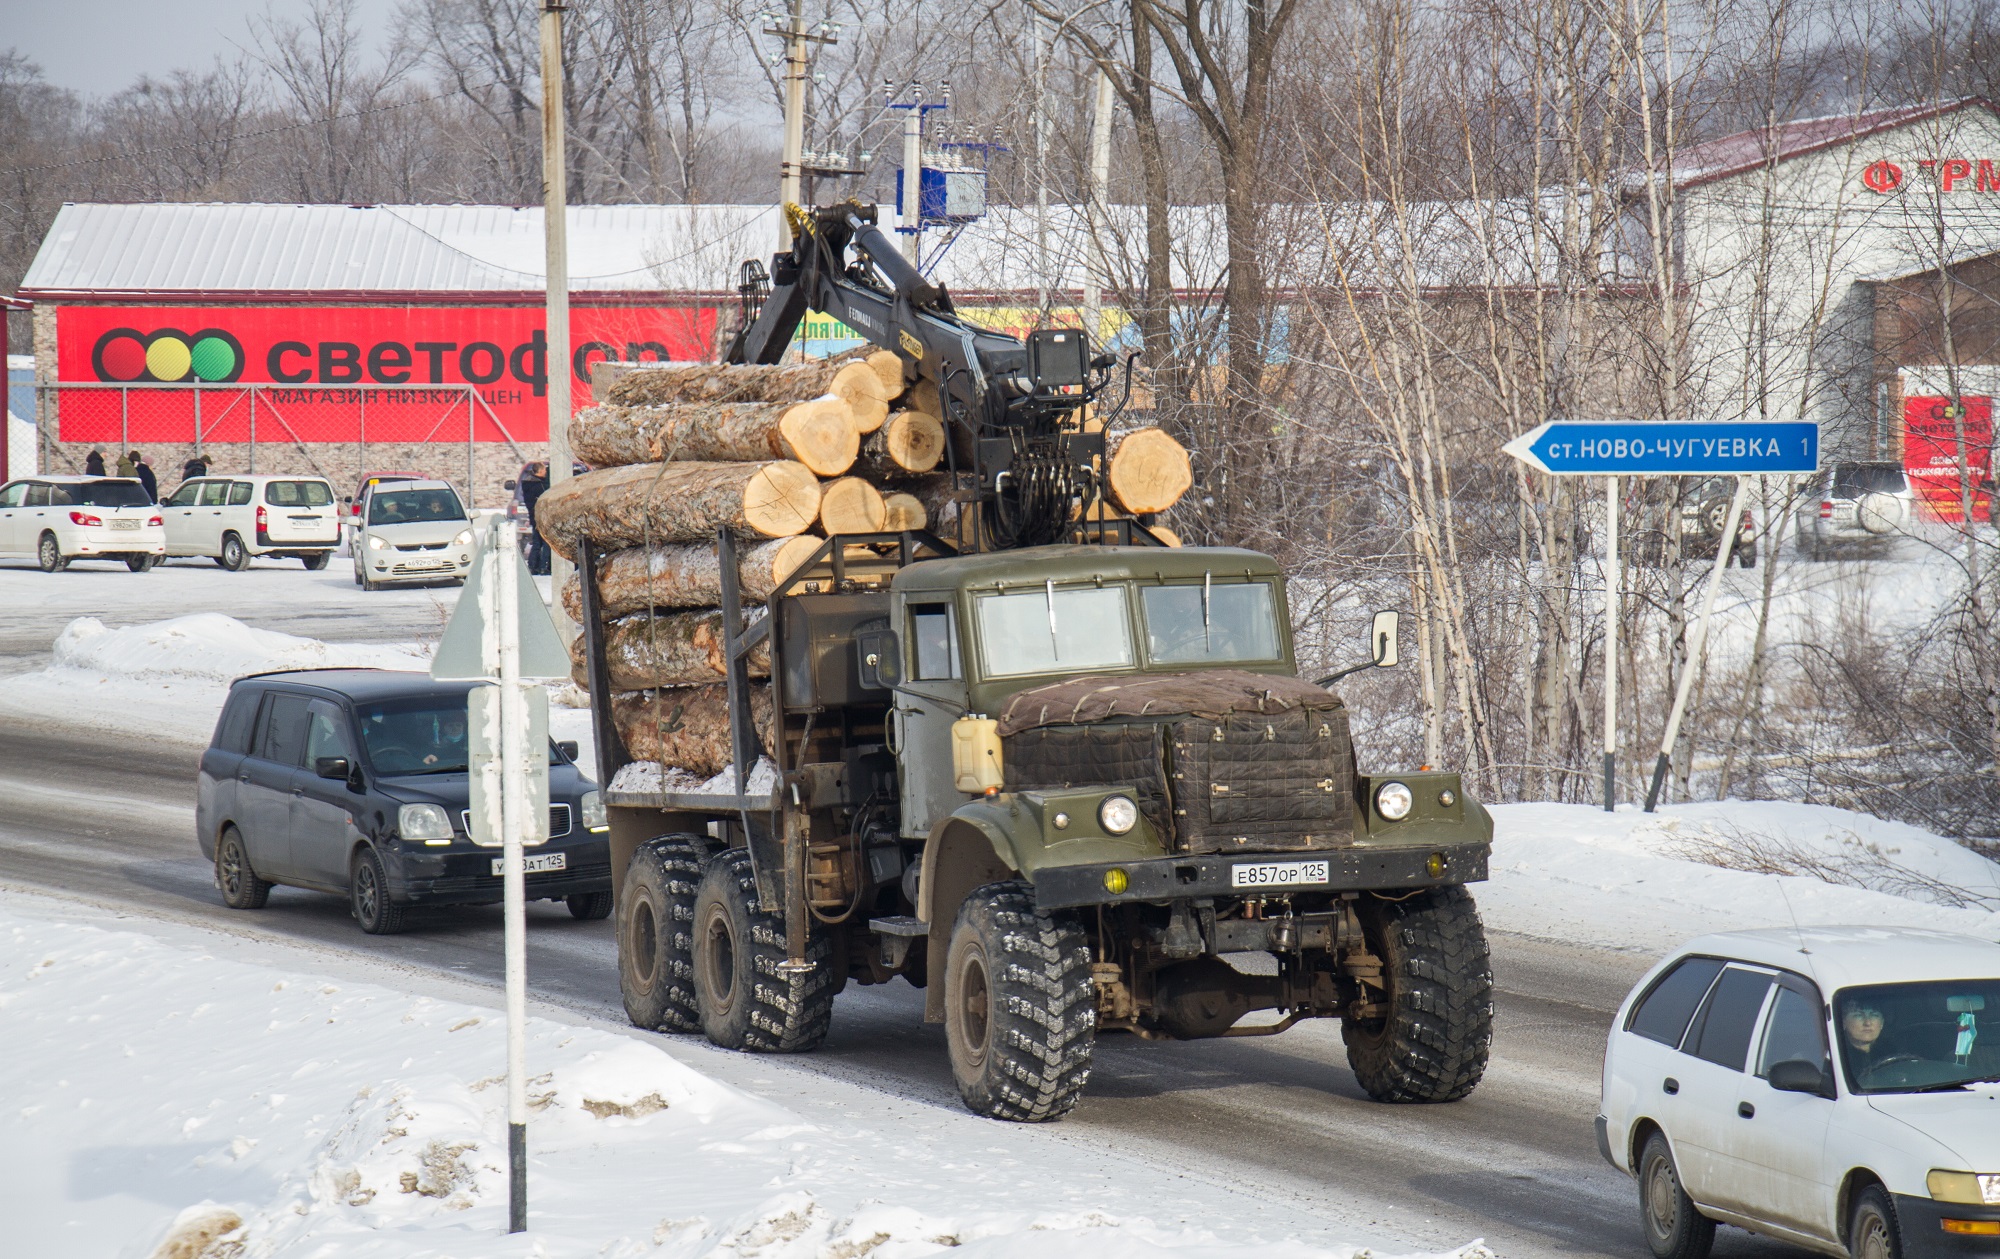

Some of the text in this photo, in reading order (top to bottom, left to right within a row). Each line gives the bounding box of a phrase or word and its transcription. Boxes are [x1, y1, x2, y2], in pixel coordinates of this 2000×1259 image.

[266, 330, 670, 397] светофо
[272, 388, 377, 404] МАГАЗИН
[482, 390, 521, 406] ЦЕН
[1549, 437, 1809, 460] ст.НОВО-ЧУГУЕВКА 1
[1929, 455, 1967, 465] ДОБР
[545, 854, 562, 866] 125
[1238, 864, 1325, 884] Е857ОР 125
